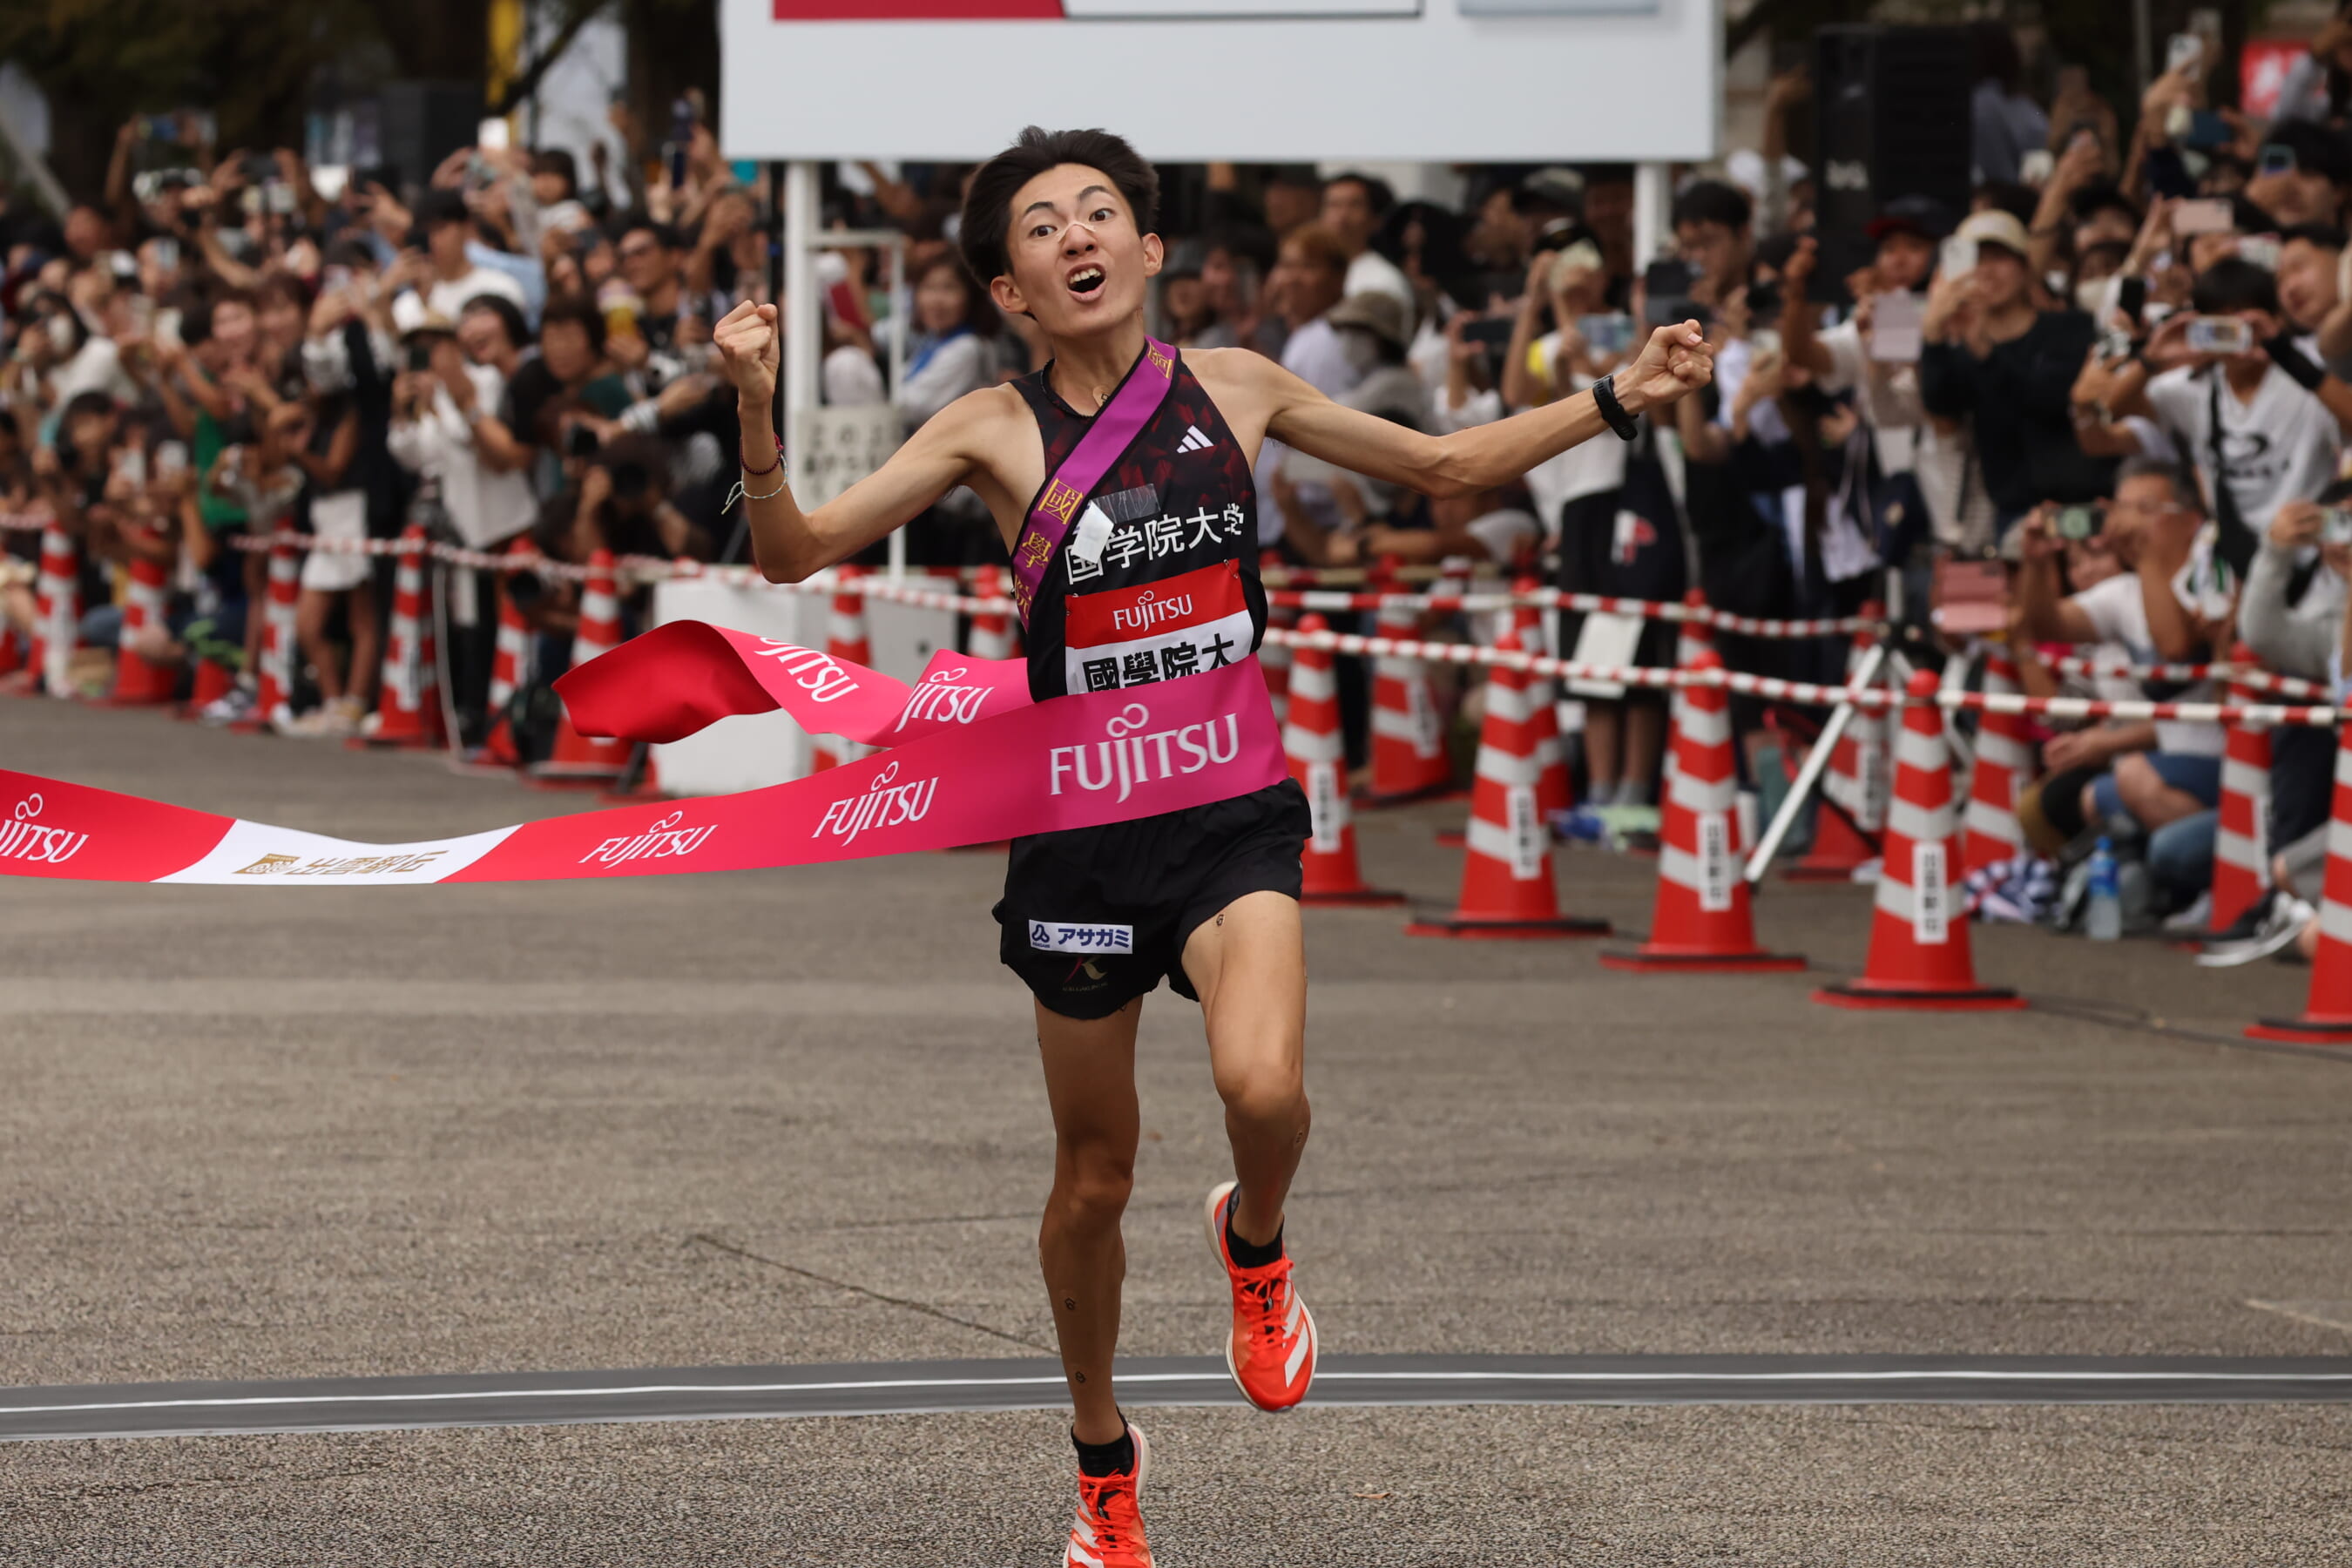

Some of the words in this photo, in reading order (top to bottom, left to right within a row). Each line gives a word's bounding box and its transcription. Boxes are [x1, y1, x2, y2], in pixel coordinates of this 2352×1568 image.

[1112, 591, 1193, 632] FUJITSU
[894, 668, 995, 733] JITSU
[1050, 703, 1240, 804] FUJITSU
[811, 760, 939, 847] FUJITSU
[578, 810, 719, 869] FUJITSU
[1058, 929, 1129, 948] アサガミ
